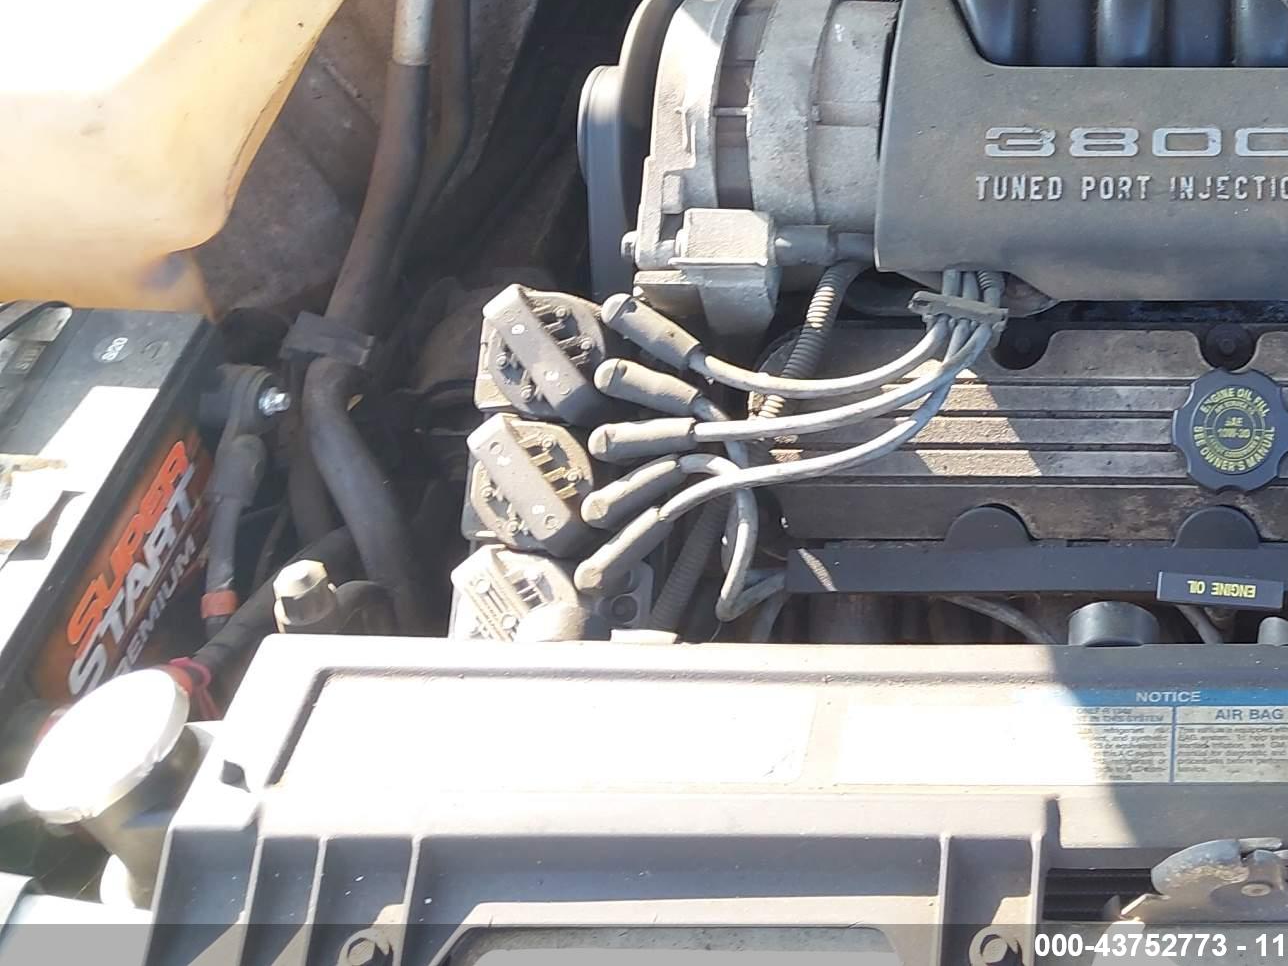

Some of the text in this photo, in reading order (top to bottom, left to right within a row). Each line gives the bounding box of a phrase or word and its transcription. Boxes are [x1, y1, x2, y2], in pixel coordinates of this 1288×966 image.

[976, 175, 1063, 201] TUNED
[1081, 175, 1152, 201] PORT
[1200, 388, 1235, 414] ENGINE
[1237, 388, 1253, 401] OIL
[1253, 396, 1270, 418] FILL
[1245, 426, 1276, 467] MANUAL
[67, 441, 190, 656] SUPER
[68, 463, 195, 696] START
[1187, 580, 1257, 598] ENGINE OIL
[113, 535, 196, 679] REMIUM
[1136, 690, 1201, 703] NOTICE
[1215, 708, 1284, 721] AIR BAG
